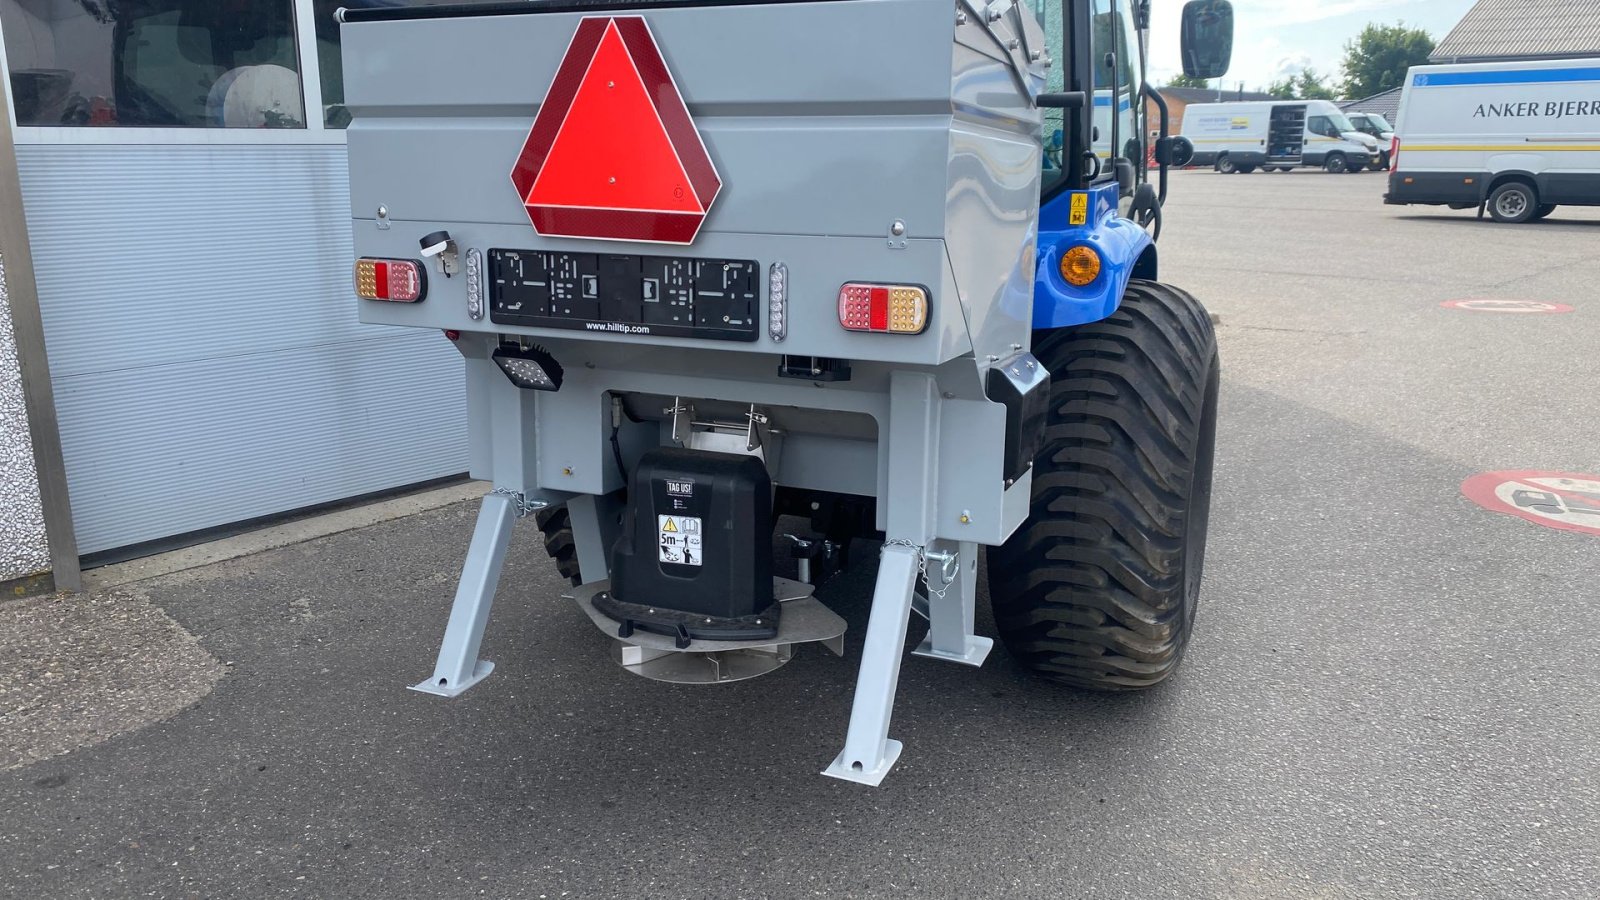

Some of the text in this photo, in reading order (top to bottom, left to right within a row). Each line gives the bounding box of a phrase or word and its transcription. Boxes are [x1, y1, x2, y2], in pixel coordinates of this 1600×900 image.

[1473, 100, 1600, 118] ANKER BJERR
[586, 322, 650, 334] www.hilltip.com
[668, 482, 691, 493] TAG US!
[661, 533, 676, 545] 5m
